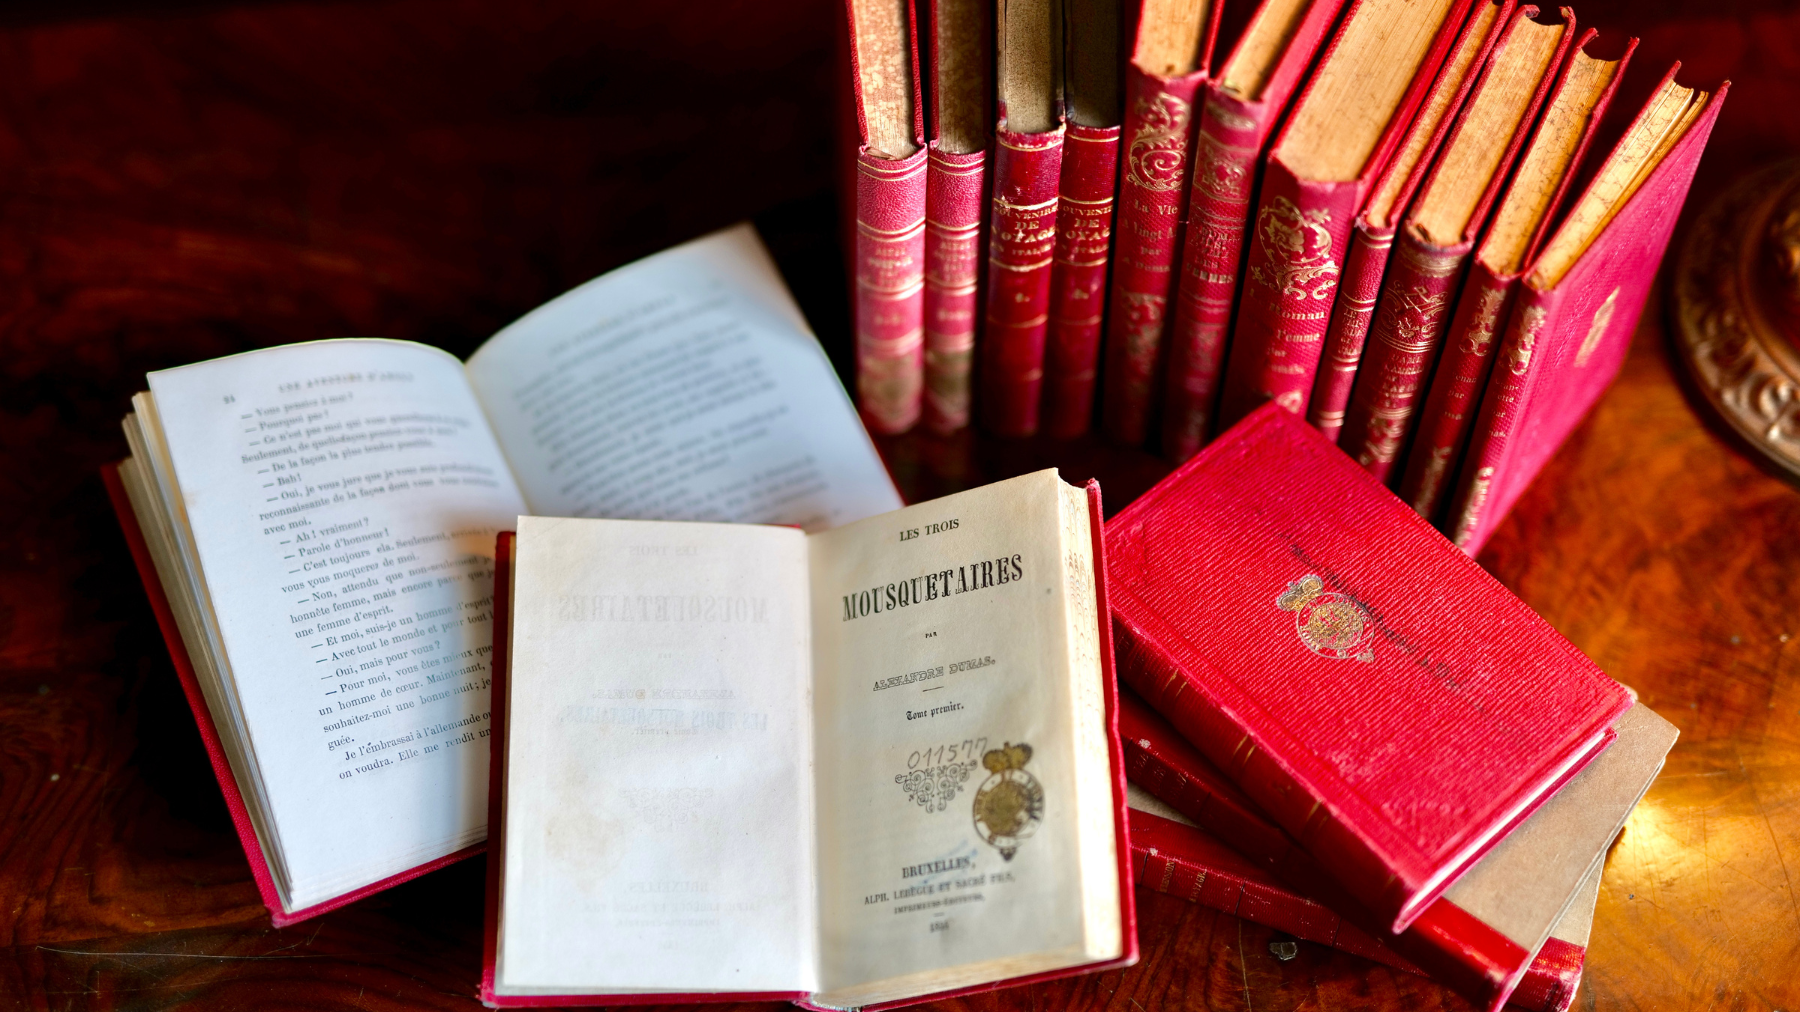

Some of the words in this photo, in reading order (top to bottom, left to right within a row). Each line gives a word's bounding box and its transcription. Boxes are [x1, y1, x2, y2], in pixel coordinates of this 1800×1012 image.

[1014, 220, 1040, 230] DE
[258, 414, 304, 431] Pourquoi
[241, 445, 298, 464] Seulement,
[271, 461, 286, 472] De
[288, 459, 299, 469] la
[300, 453, 327, 466] façon
[259, 497, 330, 521] reconnaissante
[333, 492, 345, 503] de
[347, 490, 357, 500] la
[359, 485, 385, 498] façon
[281, 488, 303, 500] Oui,
[305, 484, 315, 497] je
[318, 480, 340, 491] vous
[342, 476, 362, 488] jure
[263, 524, 286, 535] avec
[288, 516, 312, 530] moi.
[899, 528, 920, 542] LES
[924, 519, 960, 536] TROIS
[298, 543, 331, 557] Parole
[303, 559, 328, 572] C'est
[329, 549, 371, 565] toujours
[281, 581, 305, 593] vous
[382, 557, 395, 567] de
[312, 590, 337, 602] Non,
[342, 577, 379, 594] attendu
[385, 571, 403, 585] que
[842, 553, 1023, 622] MOUSQUETAIRES
[290, 607, 331, 624] honnête
[332, 597, 371, 613] femme,
[373, 588, 397, 601] mais
[401, 580, 433, 594] encore
[468, 570, 484, 581] que
[294, 627, 314, 639] une
[317, 617, 351, 633] femme
[353, 605, 394, 622] d'esprit.
[325, 636, 338, 647] Et
[340, 629, 364, 643] moi,
[365, 620, 397, 635] suis-je
[399, 616, 413, 626] un
[416, 606, 453, 622] homme
[331, 648, 356, 662] Avec
[357, 641, 377, 654] tout
[379, 638, 389, 648] le
[391, 628, 426, 644] monde
[427, 624, 438, 634] et
[441, 619, 464, 633] pour
[467, 612, 487, 624] tout
[924, 631, 938, 639] PAR
[335, 665, 358, 678] Oui,
[360, 657, 383, 671] mais
[385, 651, 409, 666] pour
[339, 680, 365, 694] Pour
[367, 671, 391, 686] moi,
[395, 664, 419, 677] vous
[421, 658, 440, 670] êtes
[442, 650, 473, 664] mieux
[872, 666, 944, 691] ALEXANDRE
[948, 655, 996, 675] DUMAS.
[318, 705, 333, 716] un
[337, 693, 377, 710] homme
[380, 688, 393, 698] de
[395, 681, 424, 694] cœur.
[426, 661, 486, 685] Maintenant,
[323, 705, 392, 733] souhaitez-moi
[395, 700, 415, 712] une
[419, 690, 451, 705] bonne
[905, 710, 928, 721] Tome
[930, 701, 965, 718] premier.
[328, 735, 355, 751] guée.
[345, 750, 357, 761] Je
[416, 729, 423, 740] à
[423, 713, 481, 737] l'allemande
[339, 769, 352, 780] on
[355, 757, 394, 775] voudra.
[398, 749, 419, 762] Elle
[423, 743, 440, 754] me
[445, 732, 475, 748] rendit
[907, 737, 988, 770] 011577
[864, 893, 890, 905] ALPH.
[937, 881, 951, 892] ET
